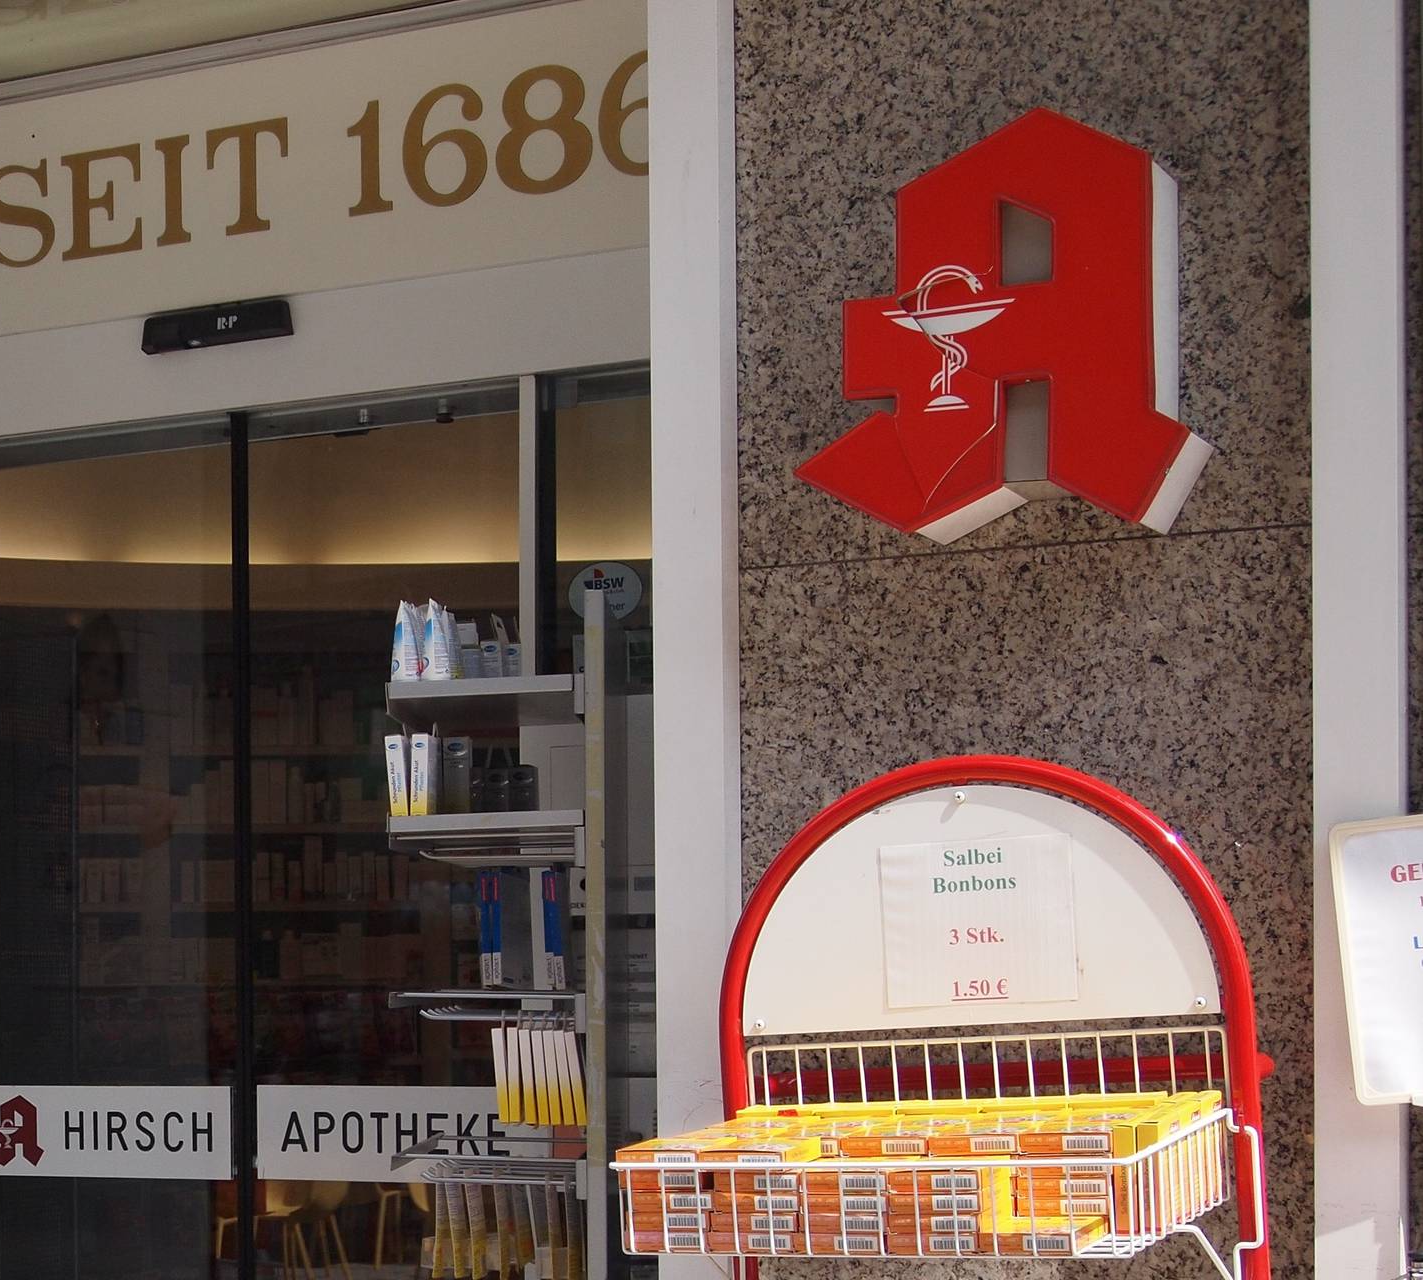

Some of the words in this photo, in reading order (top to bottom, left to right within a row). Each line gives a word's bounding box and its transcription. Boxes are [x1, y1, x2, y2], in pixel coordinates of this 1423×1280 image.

[594, 577, 624, 590] BSW
[943, 847, 1003, 867] Salbei
[933, 876, 1017, 894] Bonbons
[949, 928, 960, 945] 3
[967, 927, 1004, 944] Stk.
[953, 979, 990, 997] 1.50
[997, 978, 1008, 996] €
[63, 1111, 215, 1155] HIRSCH
[281, 1111, 510, 1157] APOTHEKE
